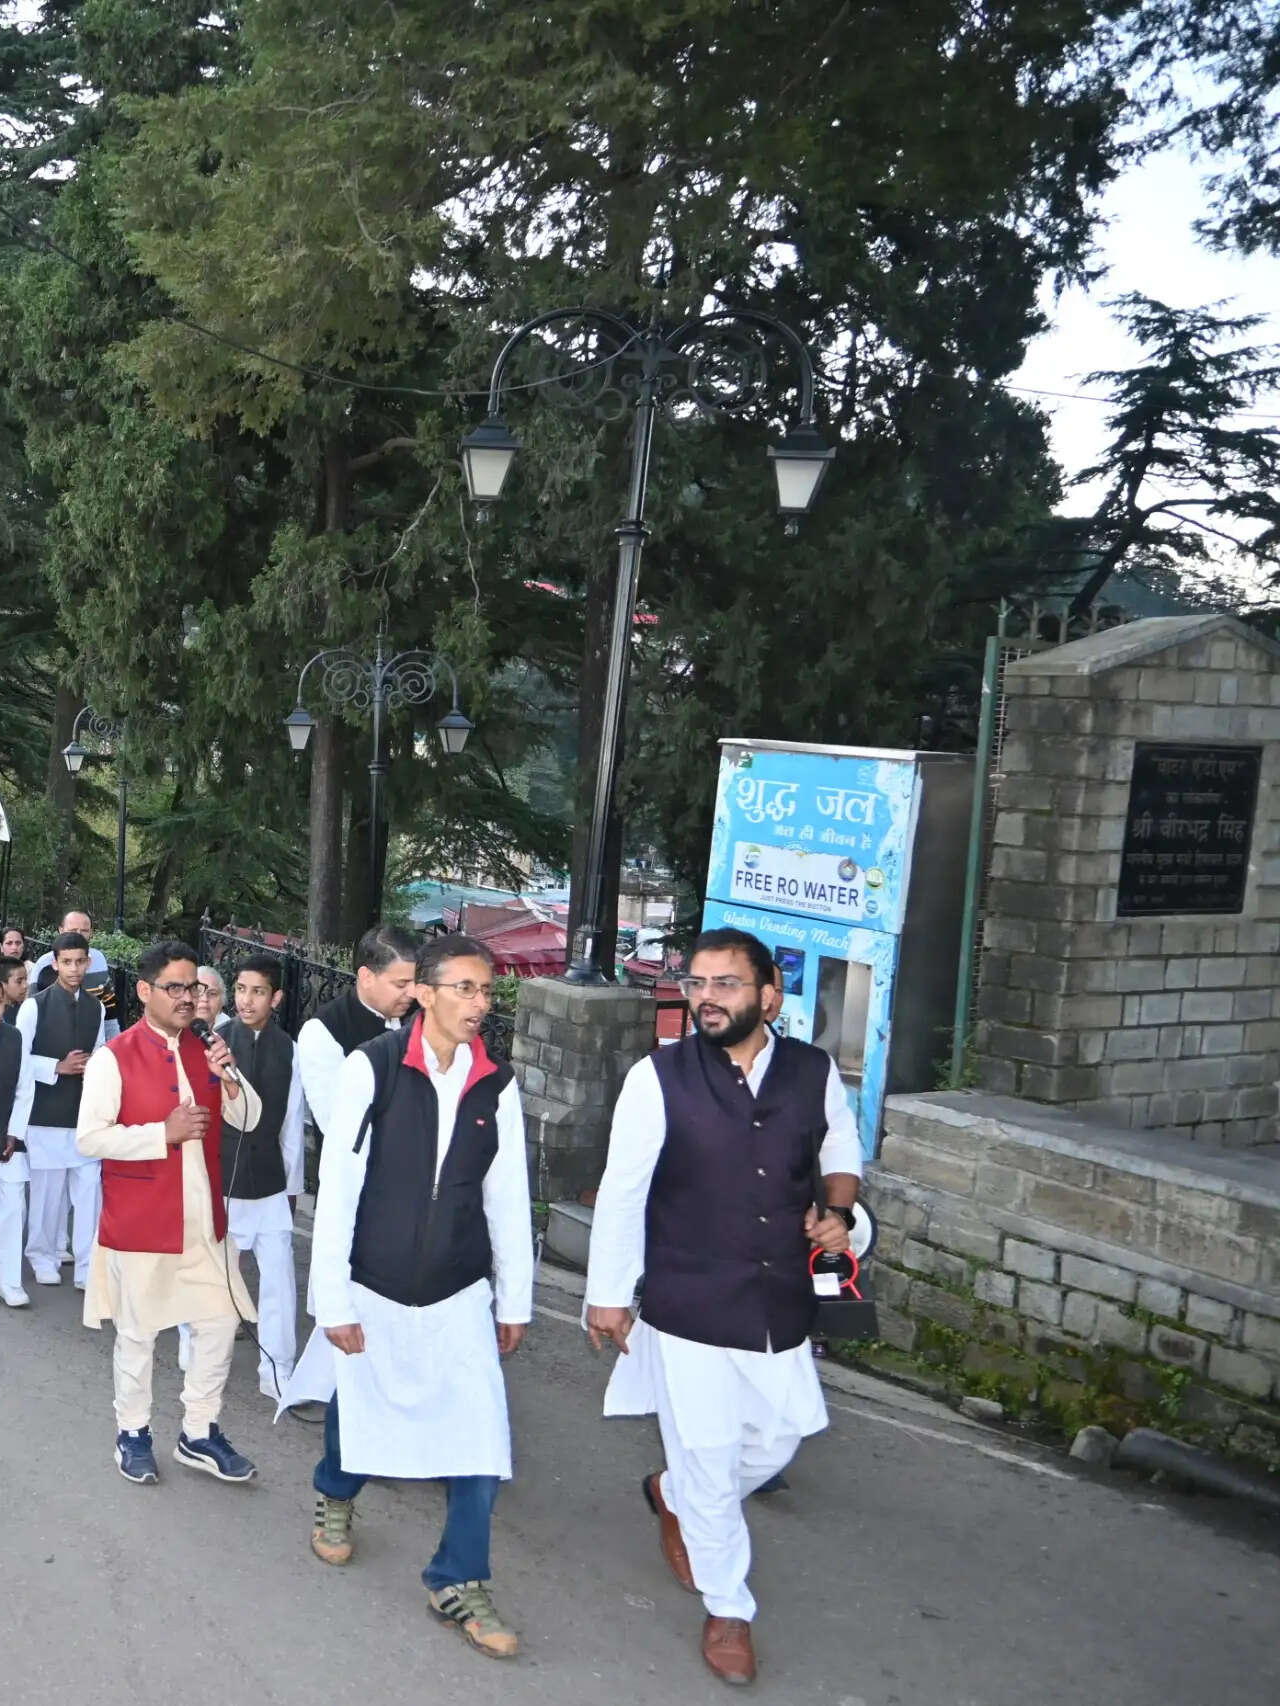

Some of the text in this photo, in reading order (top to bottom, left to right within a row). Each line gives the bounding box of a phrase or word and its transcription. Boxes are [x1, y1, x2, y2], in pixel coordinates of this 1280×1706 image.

[736, 777, 882, 825] शुद्ध जल
[735, 870, 859, 907] FREE RO WATER
[722, 911, 756, 928] Water
[759, 917, 807, 943] Vending
